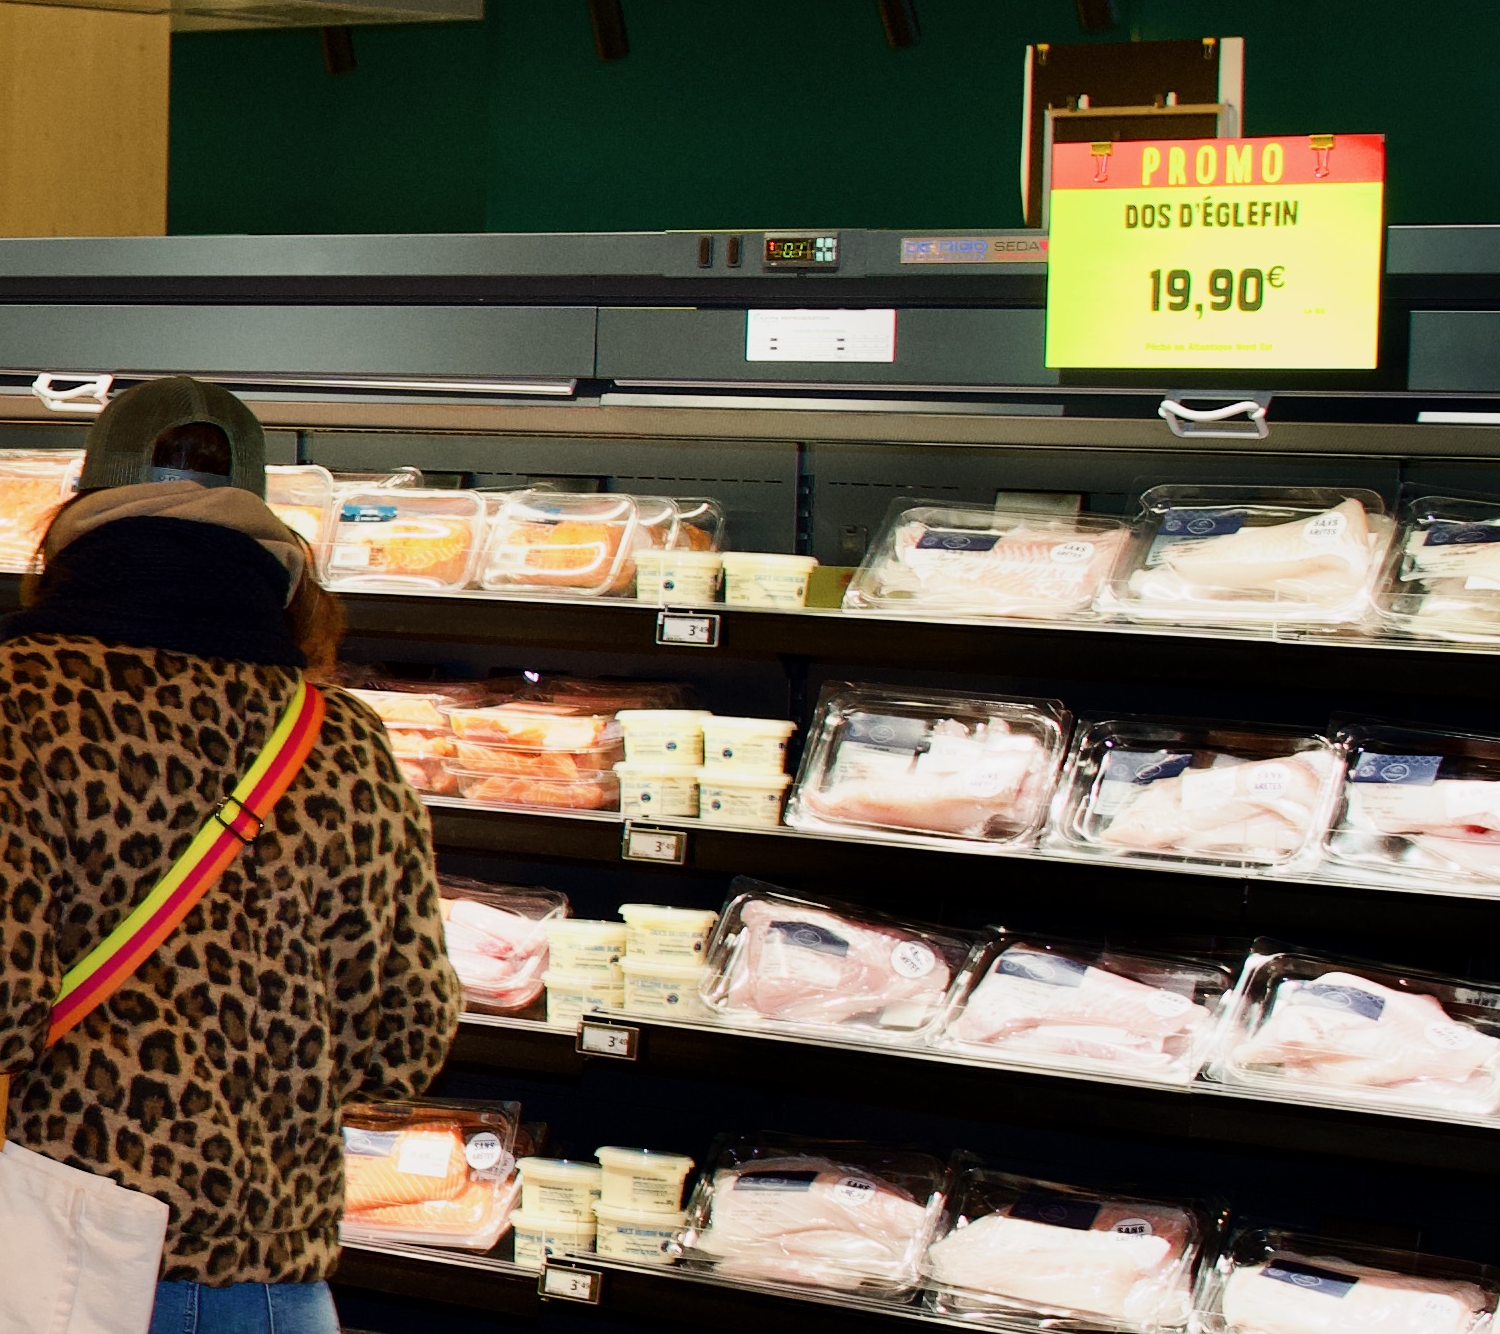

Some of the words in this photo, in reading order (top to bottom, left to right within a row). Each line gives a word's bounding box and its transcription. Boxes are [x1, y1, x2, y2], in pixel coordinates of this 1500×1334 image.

[1142, 143, 1286, 186] PROMO
[1125, 203, 1171, 229] DOS
[1180, 197, 1300, 228] D'ÉGLEFIN
[994, 241, 1040, 252] SEDA
